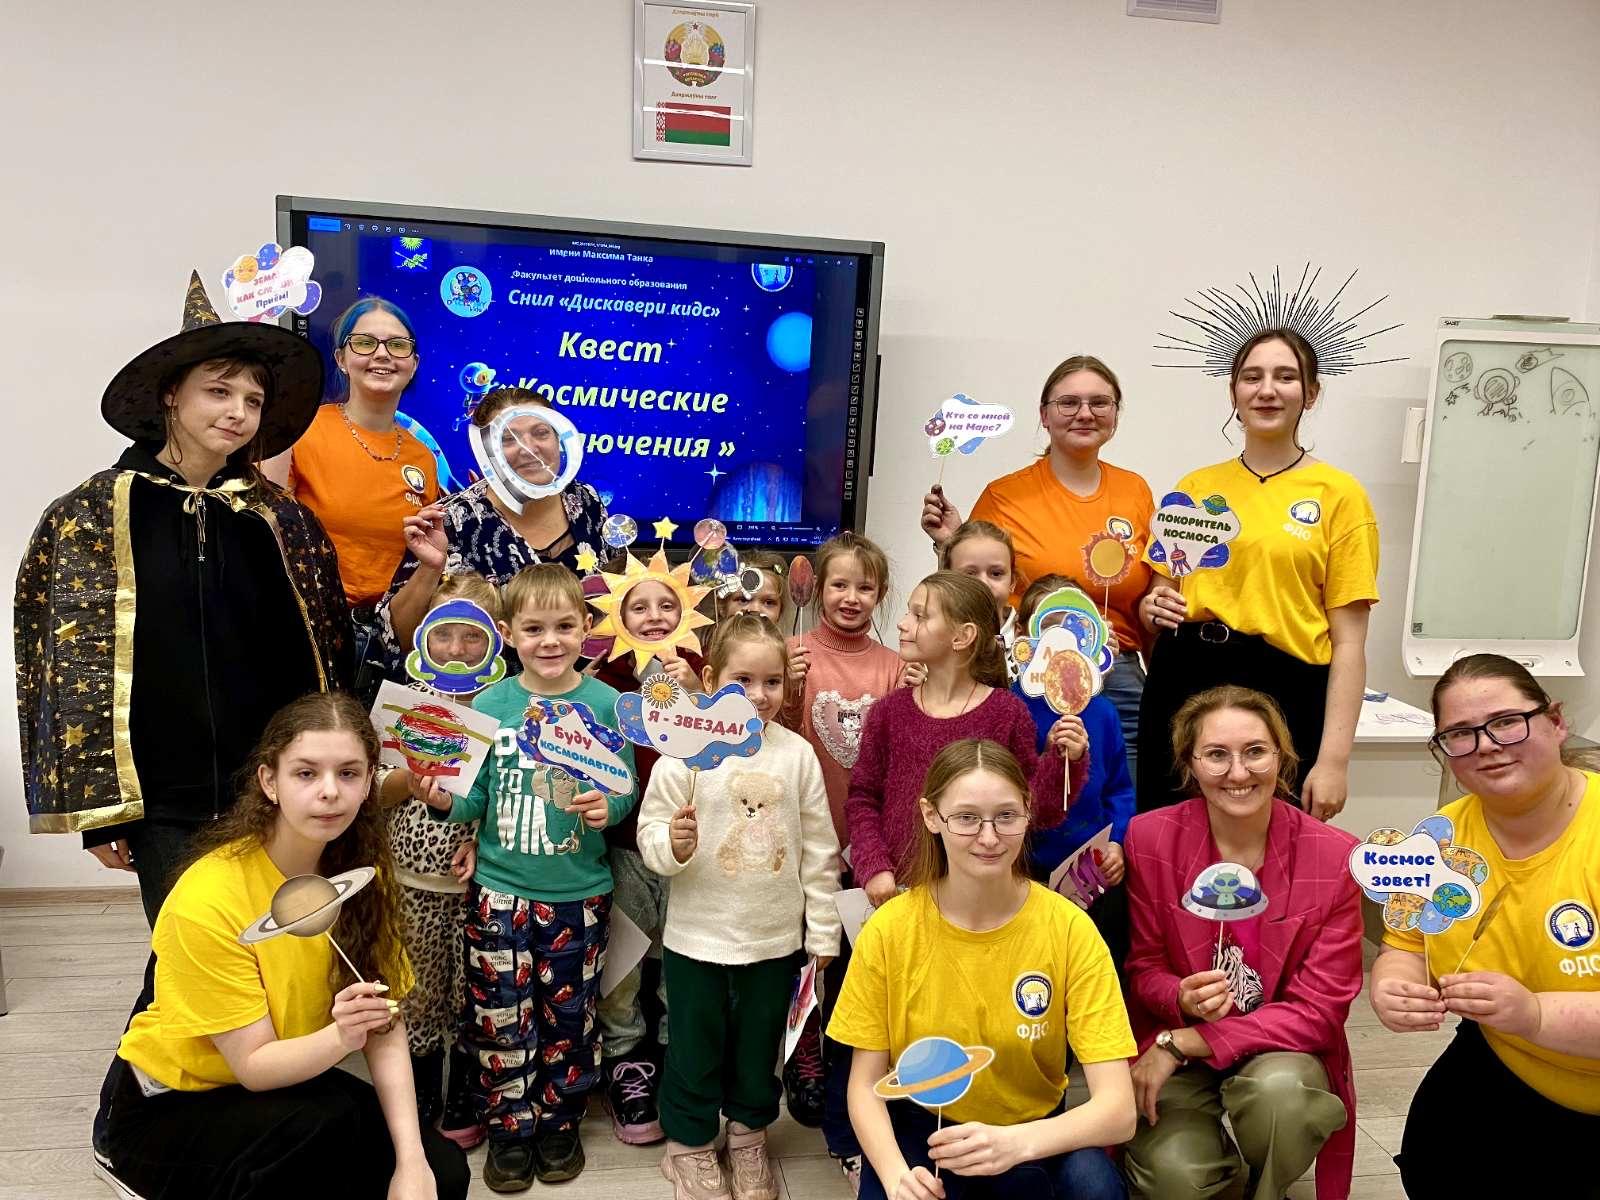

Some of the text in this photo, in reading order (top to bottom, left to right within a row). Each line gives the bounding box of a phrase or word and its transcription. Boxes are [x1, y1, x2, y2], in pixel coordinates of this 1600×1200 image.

[549, 248, 654, 263] имени Максима Танка
[511, 269, 688, 291] Факультет дошкольного образования
[508, 289, 554, 307] Снил
[560, 294, 666, 318] «Дискавери
[670, 301, 721, 318] кидс»
[558, 331, 663, 363] Квест
[945, 411, 965, 420] Кто
[981, 412, 1011, 421] мной
[948, 423, 1002, 433] на Марс?
[1156, 512, 1232, 532] ПОКОРИТЕЛЬ
[1163, 528, 1219, 545] КОСМОСА
[648, 710, 661, 723] Я
[673, 714, 745, 737] ЗВЕЗДА!
[554, 725, 593, 751] Буду
[540, 739, 628, 780] КОСМОНАВТОМ
[496, 768, 523, 794] TO
[1363, 851, 1436, 866] Космос
[1371, 873, 1431, 888] зовет!
